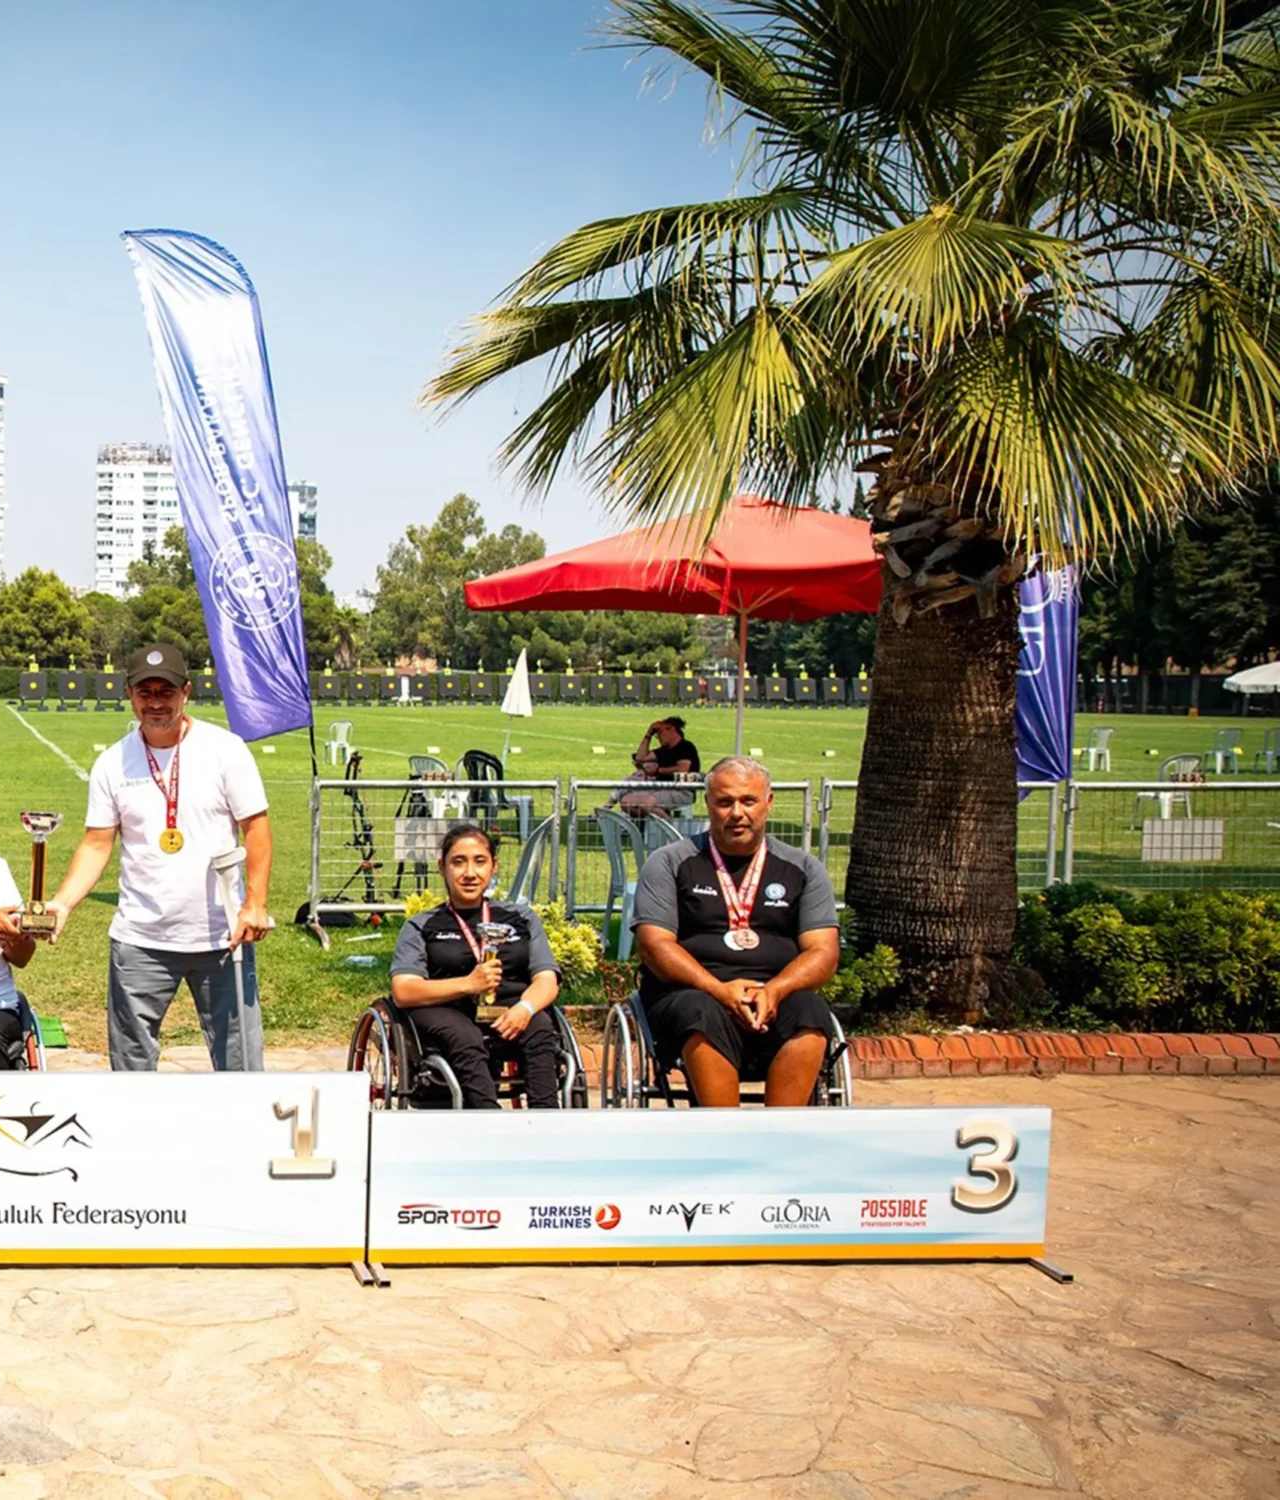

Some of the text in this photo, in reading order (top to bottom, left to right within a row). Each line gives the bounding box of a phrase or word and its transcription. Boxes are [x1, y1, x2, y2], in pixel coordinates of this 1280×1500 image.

[268, 1083, 336, 1180] 1
[951, 1120, 1019, 1214] 3
[52, 1202, 187, 1229] Federasyonu
[528, 1217, 592, 1229] AIRLINES
[529, 1206, 592, 1217] TURKISH
[649, 1202, 732, 1232] NAVEK
[761, 1202, 831, 1223] GLORIA
